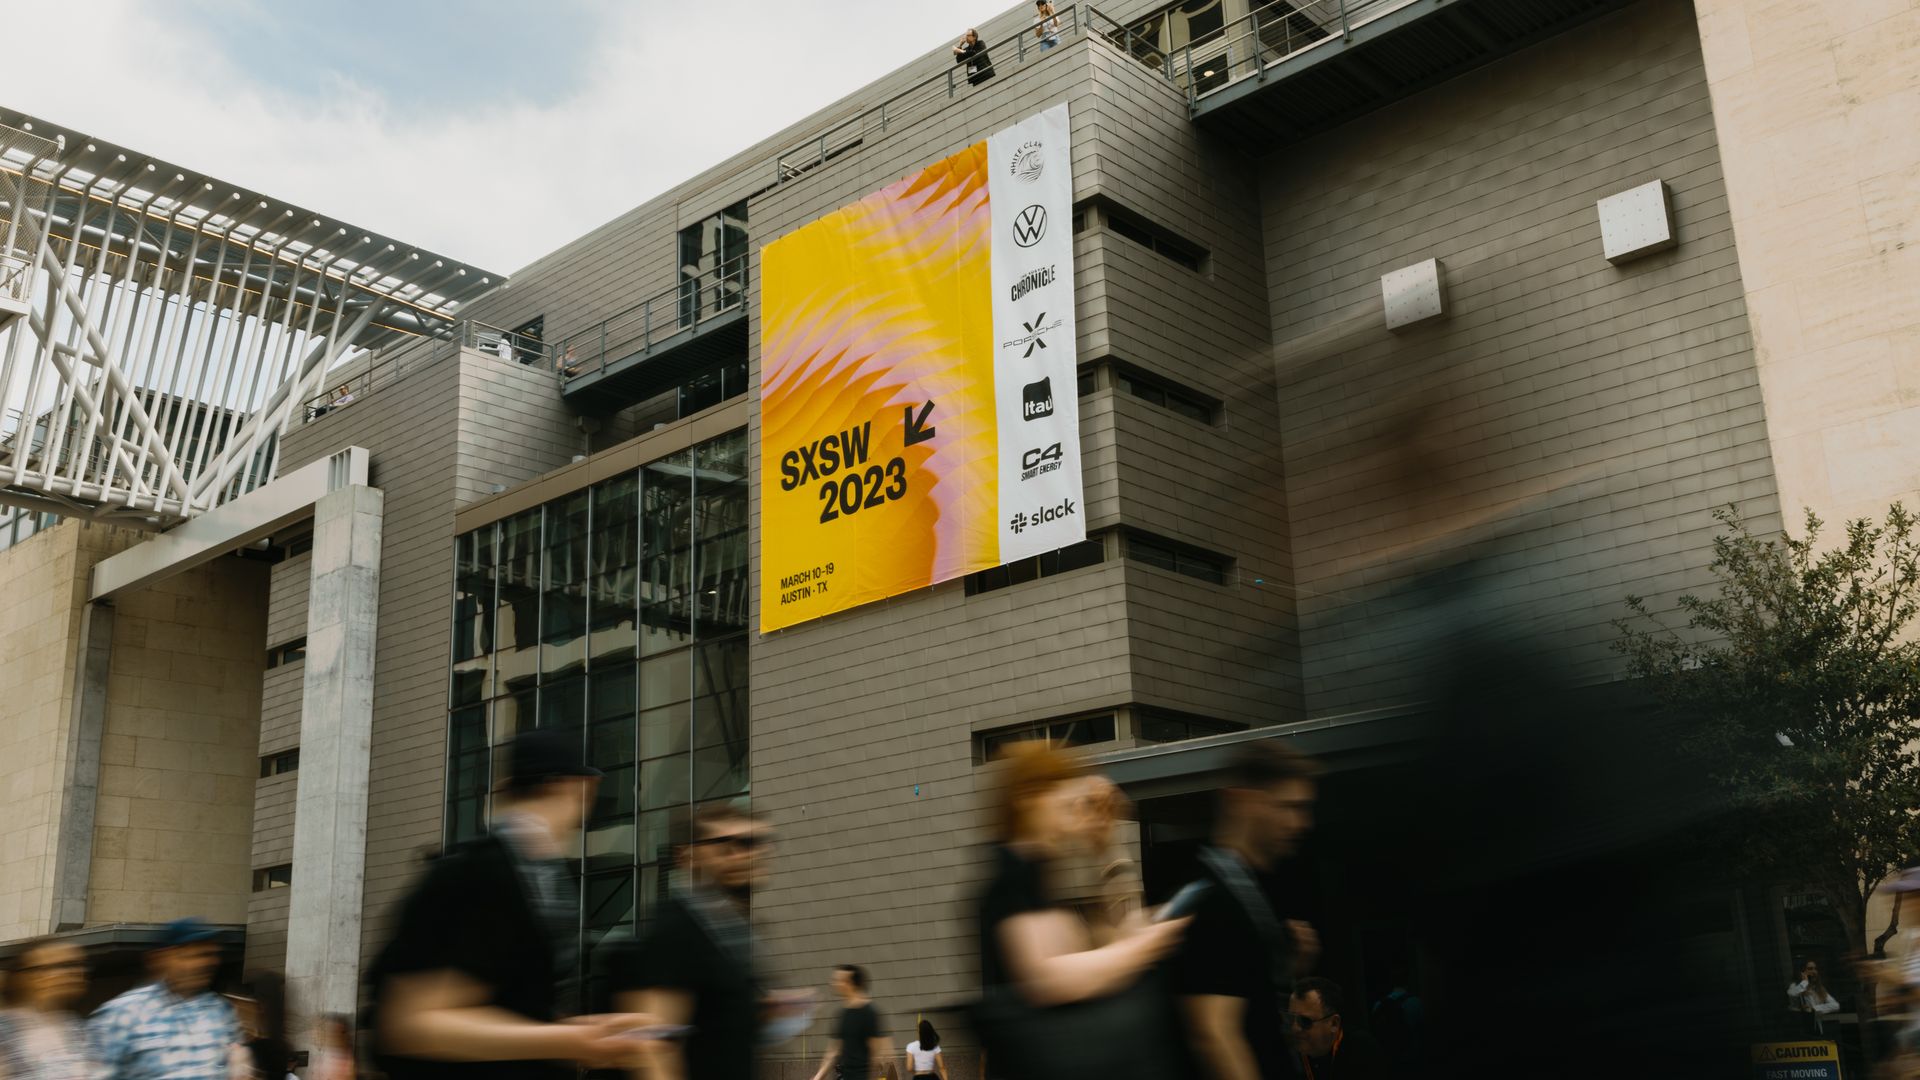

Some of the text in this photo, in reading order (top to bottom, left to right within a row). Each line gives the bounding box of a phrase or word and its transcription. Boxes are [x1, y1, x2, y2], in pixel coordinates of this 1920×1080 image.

[1011, 264, 1056, 302] CHRONICLE
[781, 421, 871, 491] SXSW
[1022, 442, 1063, 470] C4
[1021, 460, 1062, 481] SMART ENERGY
[820, 457, 907, 524] 2023
[1031, 498, 1075, 526] slack
[781, 570, 810, 590] MARCH
[781, 586, 810, 605] AUSTIN
[817, 580, 828, 594] TX
[1775, 1045, 1829, 1058] CAUTION
[1766, 1068, 1828, 1080] FAST MOVING
